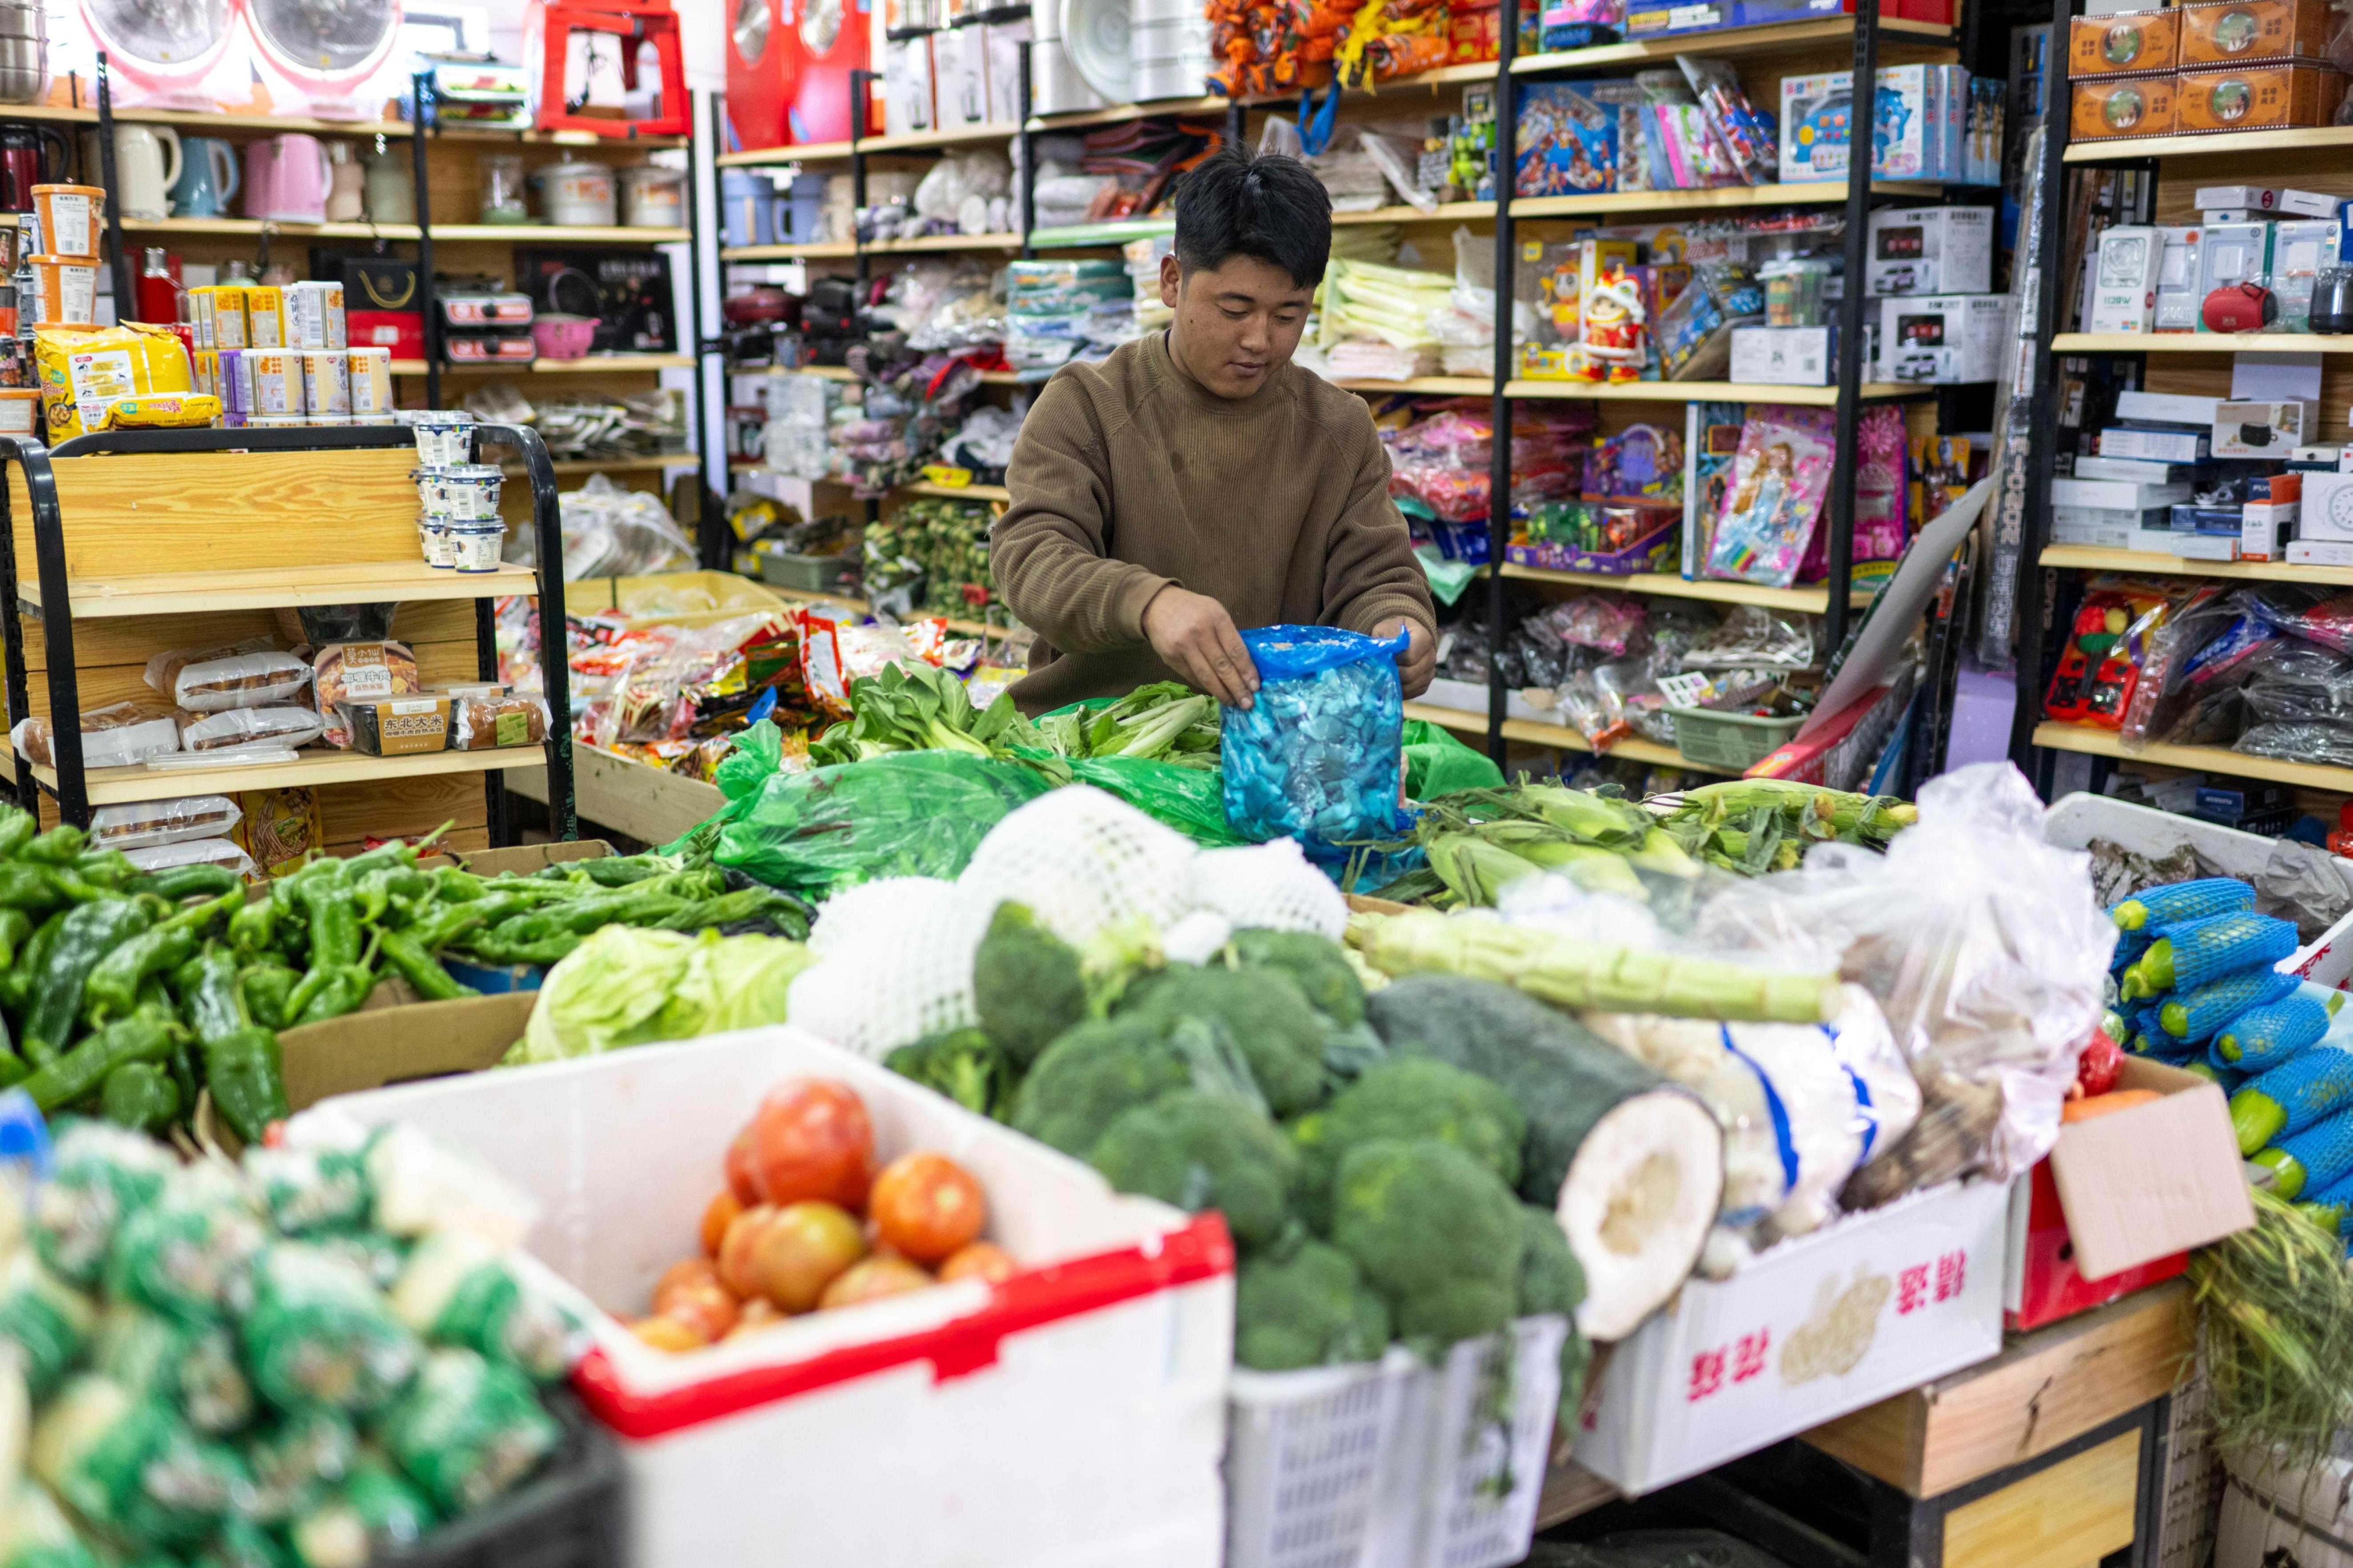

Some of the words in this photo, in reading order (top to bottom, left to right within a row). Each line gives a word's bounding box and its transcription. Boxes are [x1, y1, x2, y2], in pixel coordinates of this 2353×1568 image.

[347, 647, 379, 664] 莫小仙
[341, 670, 391, 683] 咖喱牛肉
[385, 715, 443, 729] 东北大米
